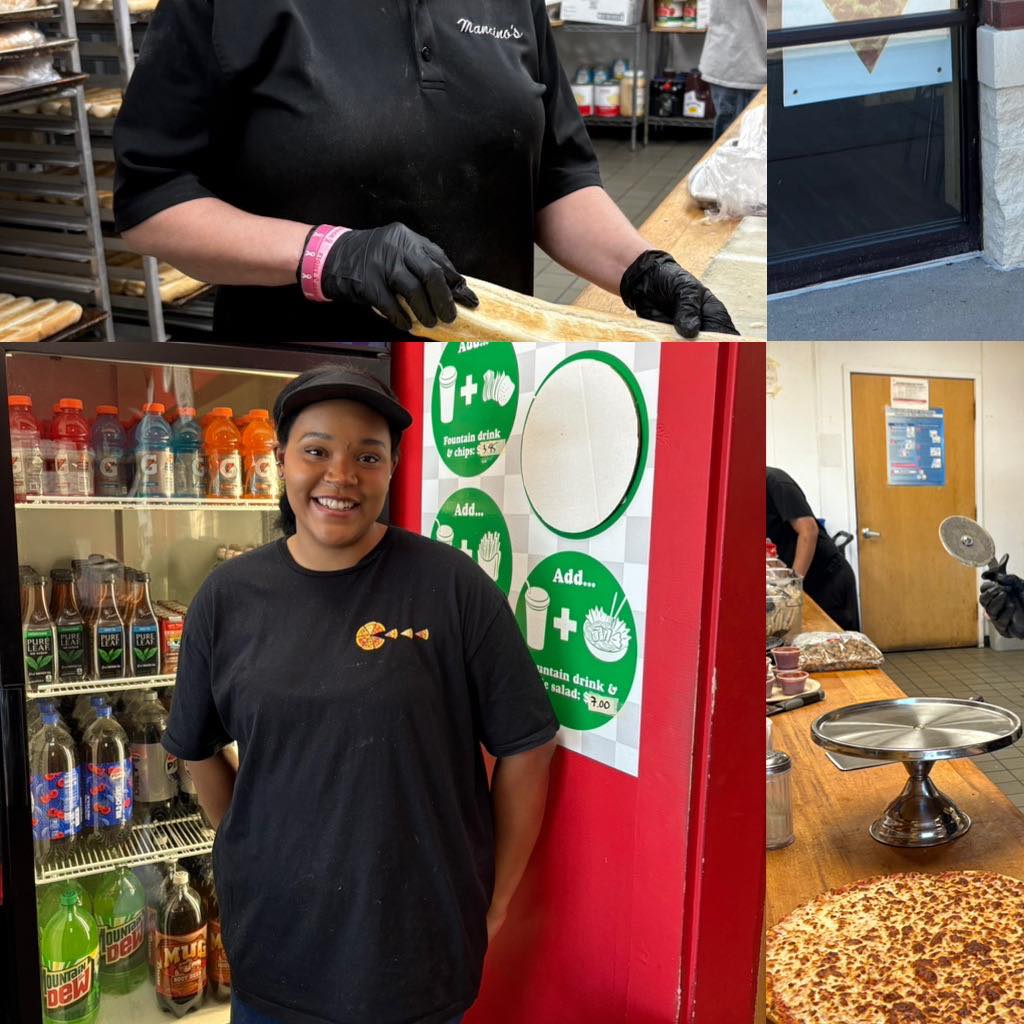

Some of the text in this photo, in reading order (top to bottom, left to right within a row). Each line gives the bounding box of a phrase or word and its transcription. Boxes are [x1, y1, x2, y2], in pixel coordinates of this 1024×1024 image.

[456, 17, 524, 40] Mancino's
[443, 428, 501, 446] Fountain drink
[454, 445, 475, 459] chips:
[100, 633, 120, 641] PURE
[136, 632, 156, 640] PURE
[27, 644, 50, 653] LEAF
[60, 639, 80, 647] LEAF
[100, 640, 119, 648] LEAF
[136, 639, 155, 647] LEAF
[536, 664, 619, 696] untain drink &
[550, 682, 581, 701] salad:
[163, 939, 207, 969] MUG
